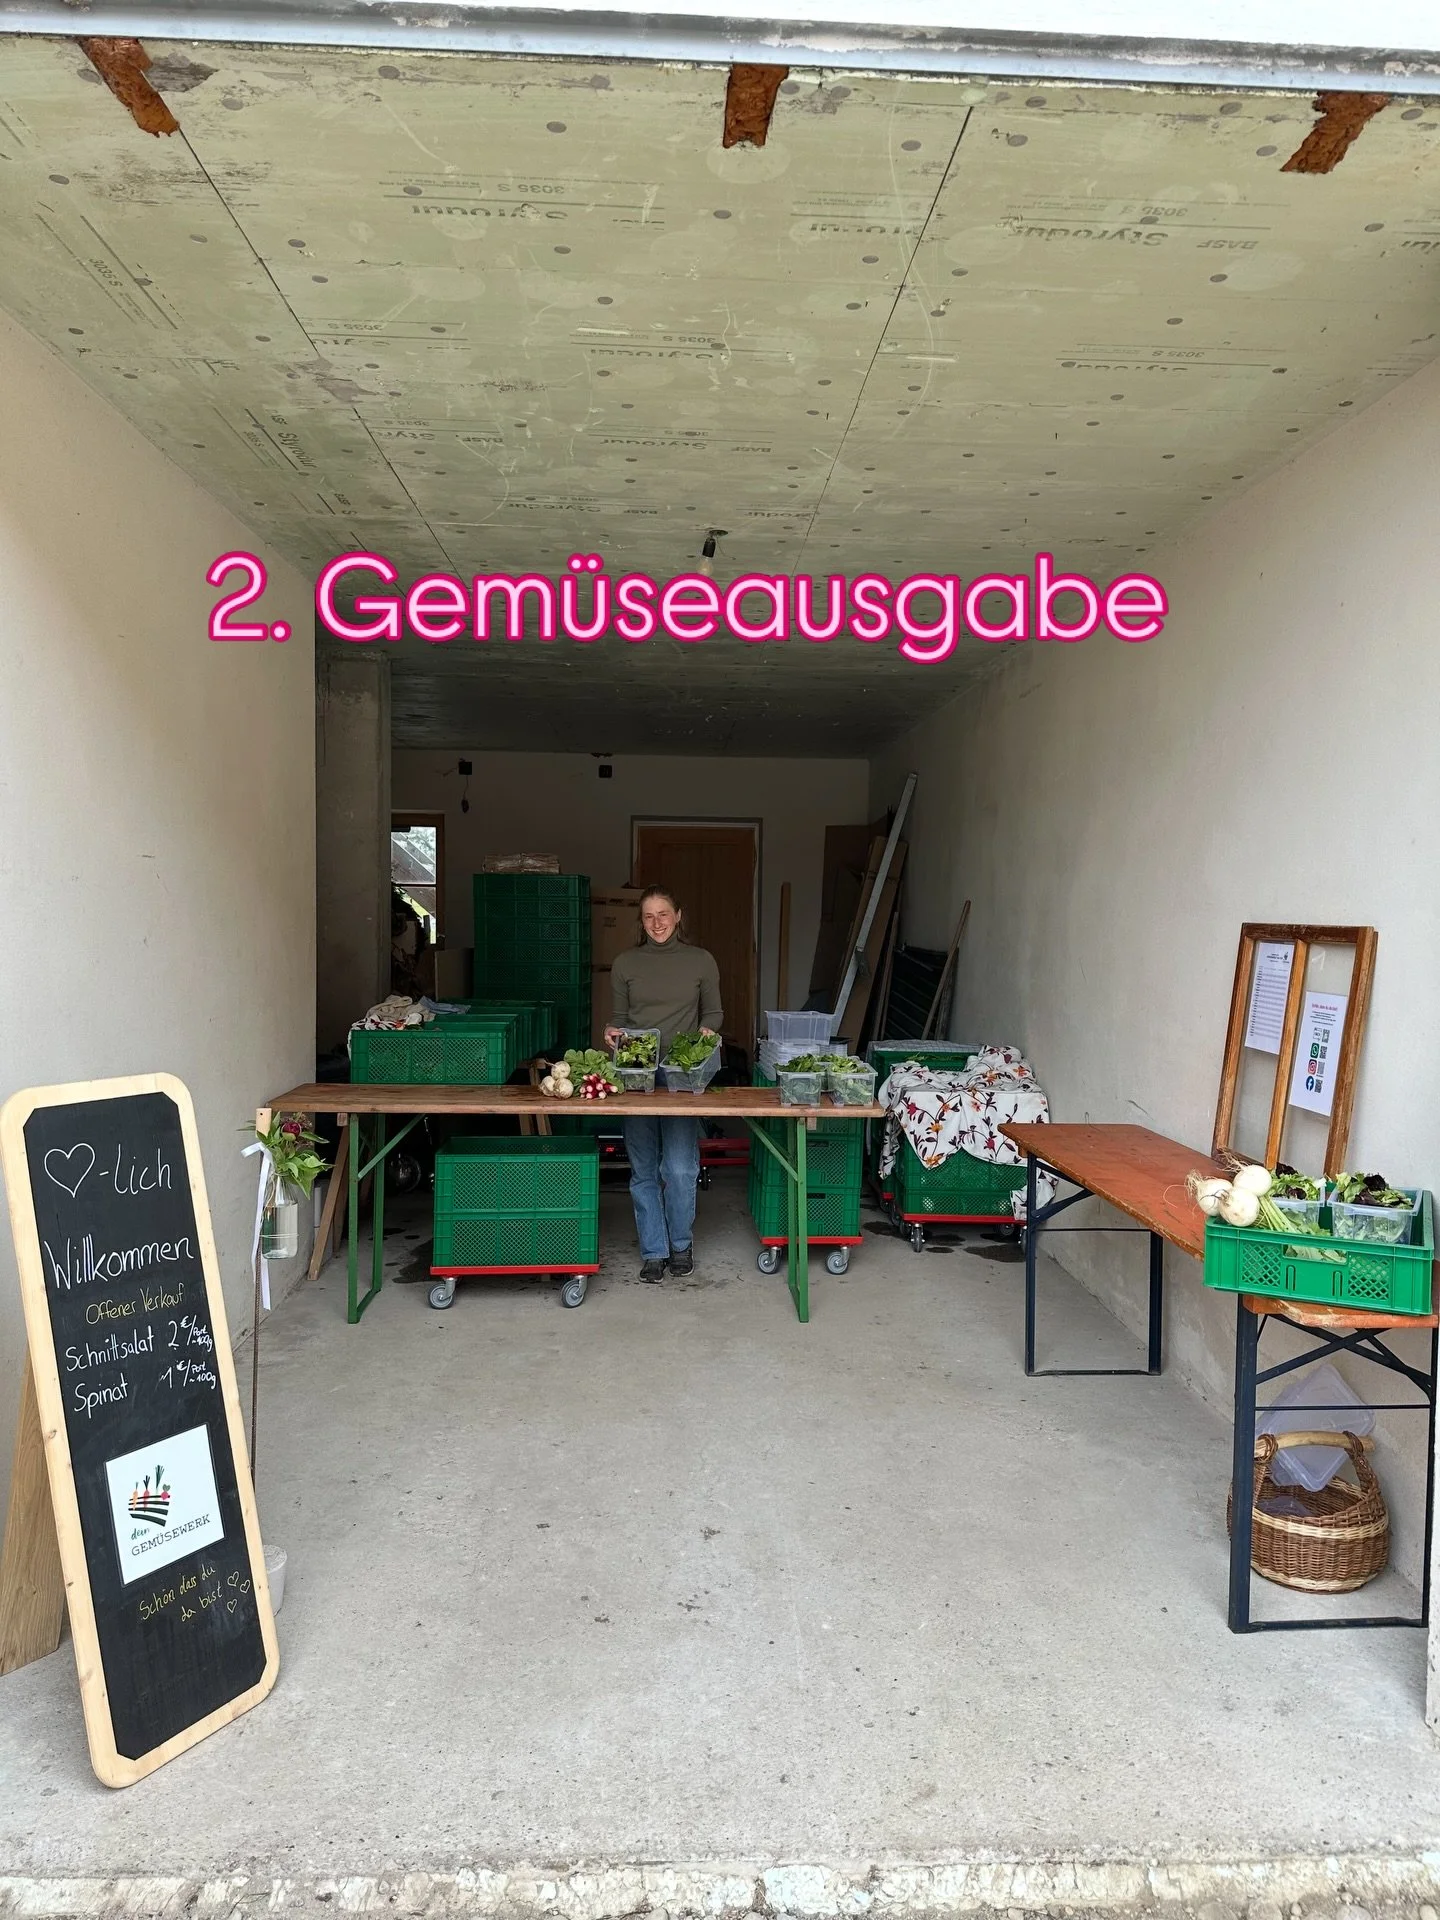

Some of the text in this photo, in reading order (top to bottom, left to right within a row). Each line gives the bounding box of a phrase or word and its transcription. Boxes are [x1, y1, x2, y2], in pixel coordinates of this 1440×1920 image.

[44, 1233, 194, 1290] Willkommen
[86, 1282, 185, 1325] Offener Verkauf
[65, 1326, 156, 1371] Schnittsalat
[73, 1373, 129, 1419] Spinat
[131, 1527, 150, 1541] dein
[131, 1513, 211, 1556] GEMÜSEWERK
[140, 1563, 216, 1621] Schön dass du
[181, 1580, 223, 1622] da bist
